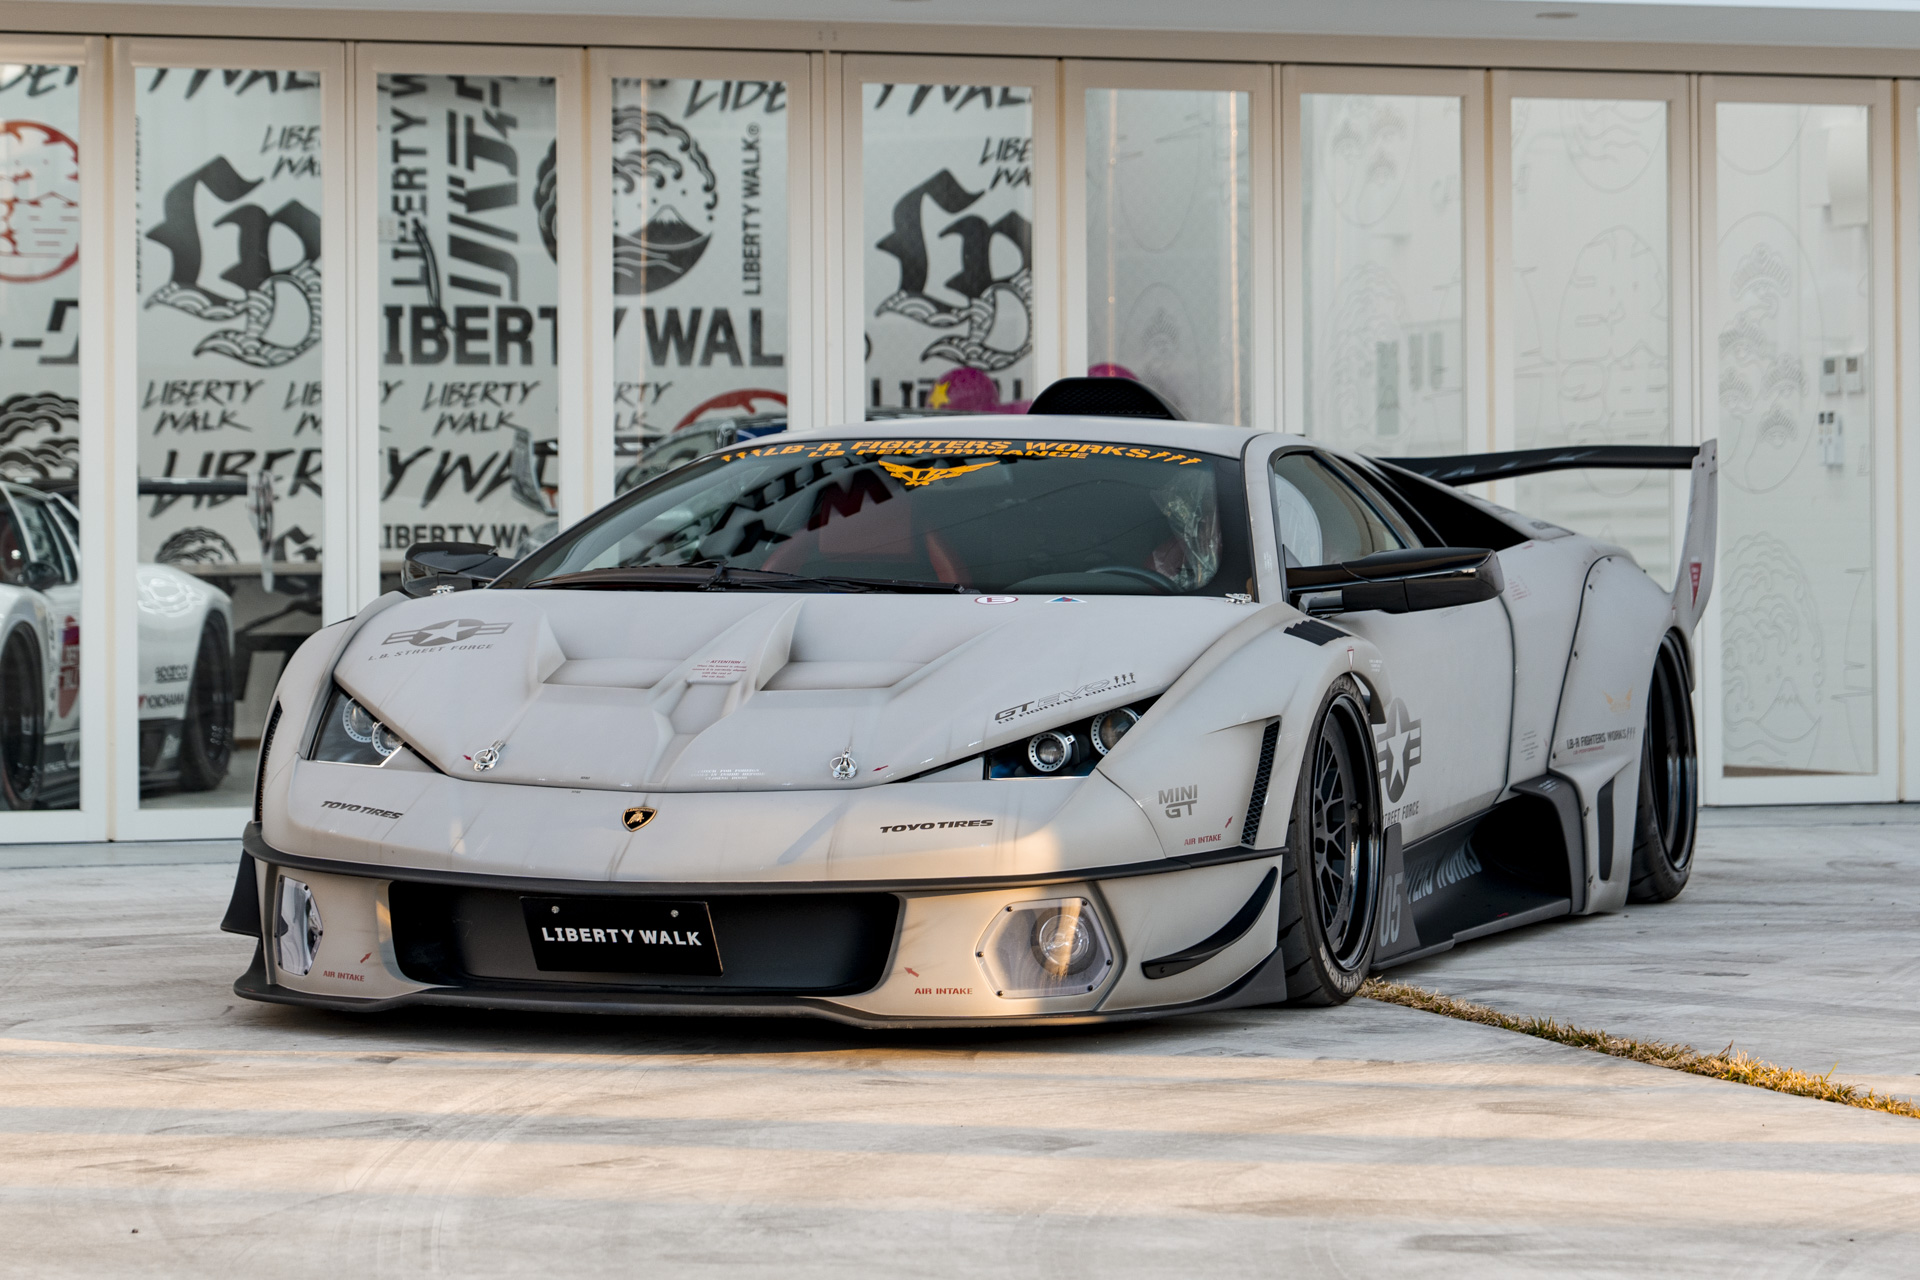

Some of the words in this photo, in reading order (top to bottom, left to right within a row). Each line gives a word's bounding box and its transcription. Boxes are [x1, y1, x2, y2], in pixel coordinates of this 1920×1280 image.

[742, 204, 761, 295] LIBERTY
[142, 379, 265, 411] LIBERTY
[422, 380, 541, 411] LIBERTY
[153, 410, 252, 436] WALK
[433, 410, 530, 437] WALK
[762, 442, 842, 457] LB-R
[850, 440, 1012, 450] FIGHTERS
[856, 449, 1089, 459] PERFORMANCE
[394, 645, 446, 657] STREET
[451, 643, 495, 651] FORCE
[995, 700, 1035, 721] GT
[1158, 784, 1198, 805] MINI
[321, 800, 361, 811] TOYO
[360, 806, 404, 819] TIRES
[1165, 800, 1197, 818] GT
[1383, 808, 1401, 827] TREET
[1402, 801, 1420, 820] FORCE
[880, 822, 935, 833] TOYO
[937, 819, 994, 829] TIRES
[1184, 837, 1196, 846] AIR
[1197, 833, 1222, 844] INTAKE
[541, 927, 634, 944] LIBERTY
[639, 929, 702, 946] WALK
[323, 970, 335, 978] AIR
[337, 972, 365, 982] INTAKE
[914, 987, 932, 995] AIR
[936, 987, 973, 995] INTAKE
